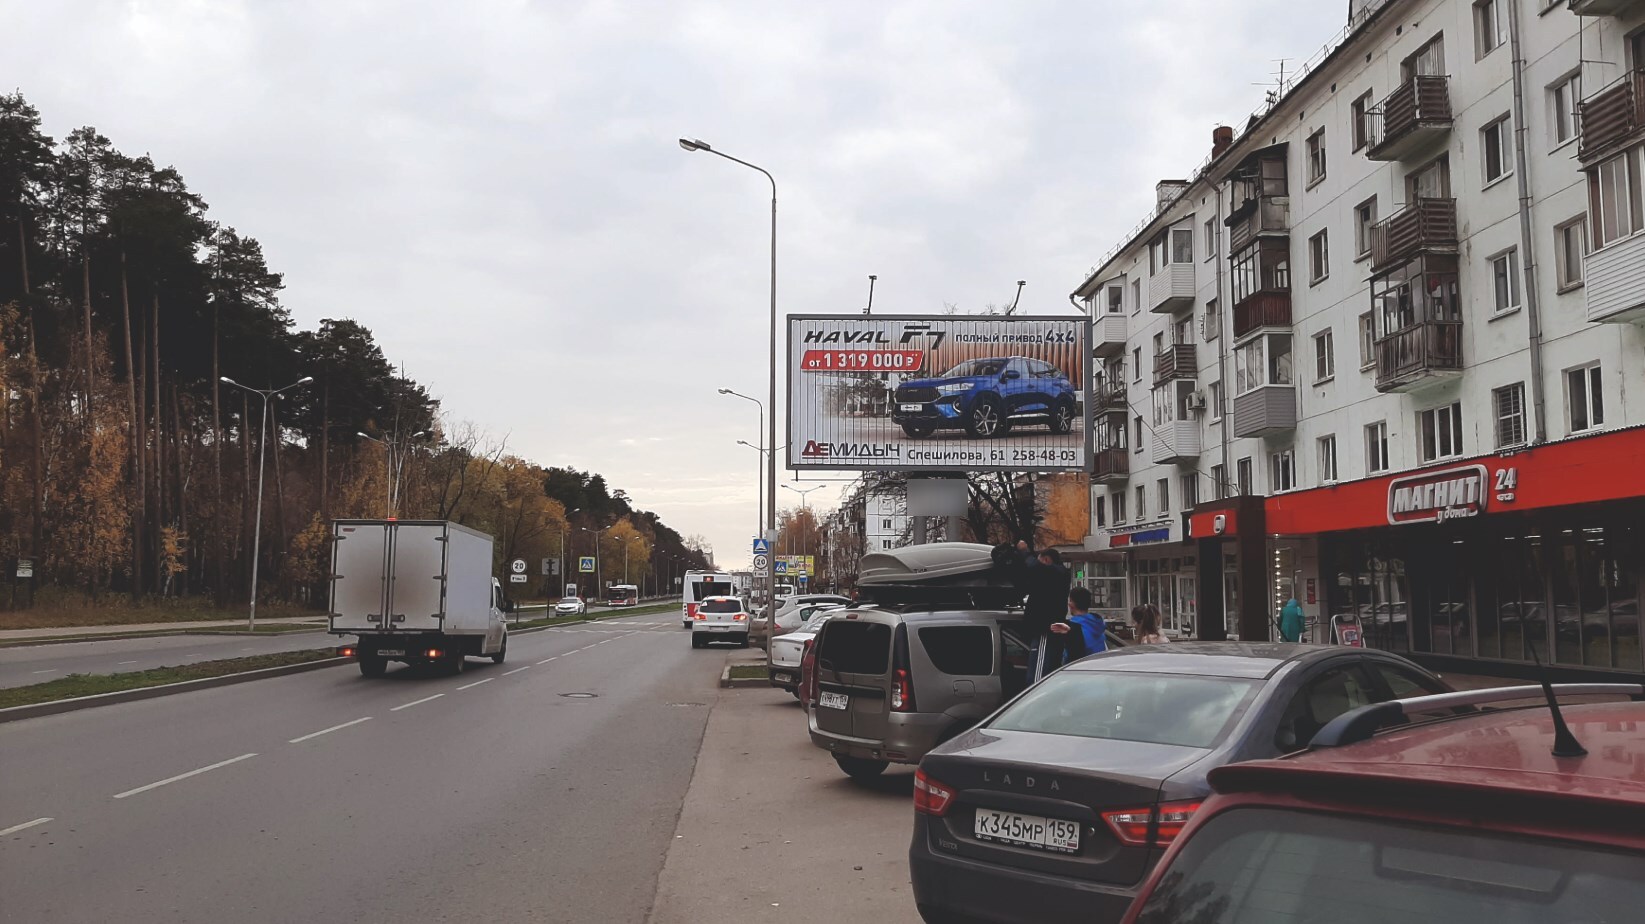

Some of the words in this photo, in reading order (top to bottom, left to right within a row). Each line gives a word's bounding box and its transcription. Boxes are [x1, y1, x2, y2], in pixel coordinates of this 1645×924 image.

[803, 330, 891, 343] HAVAL
[899, 325, 946, 350] F7
[801, 440, 900, 457] ДЕМИДЫЧ
[908, 449, 986, 461] Спешилова,
[990, 450, 1005, 461] 61
[1012, 450, 1076, 461] 258-48-03
[1495, 468, 1516, 490] 24
[1393, 476, 1478, 512] МАГНИТ
[756, 558, 766, 566] 20
[983, 771, 1060, 791] LADA
[1048, 820, 1076, 840] 159
[1053, 837, 1067, 847] RUS
